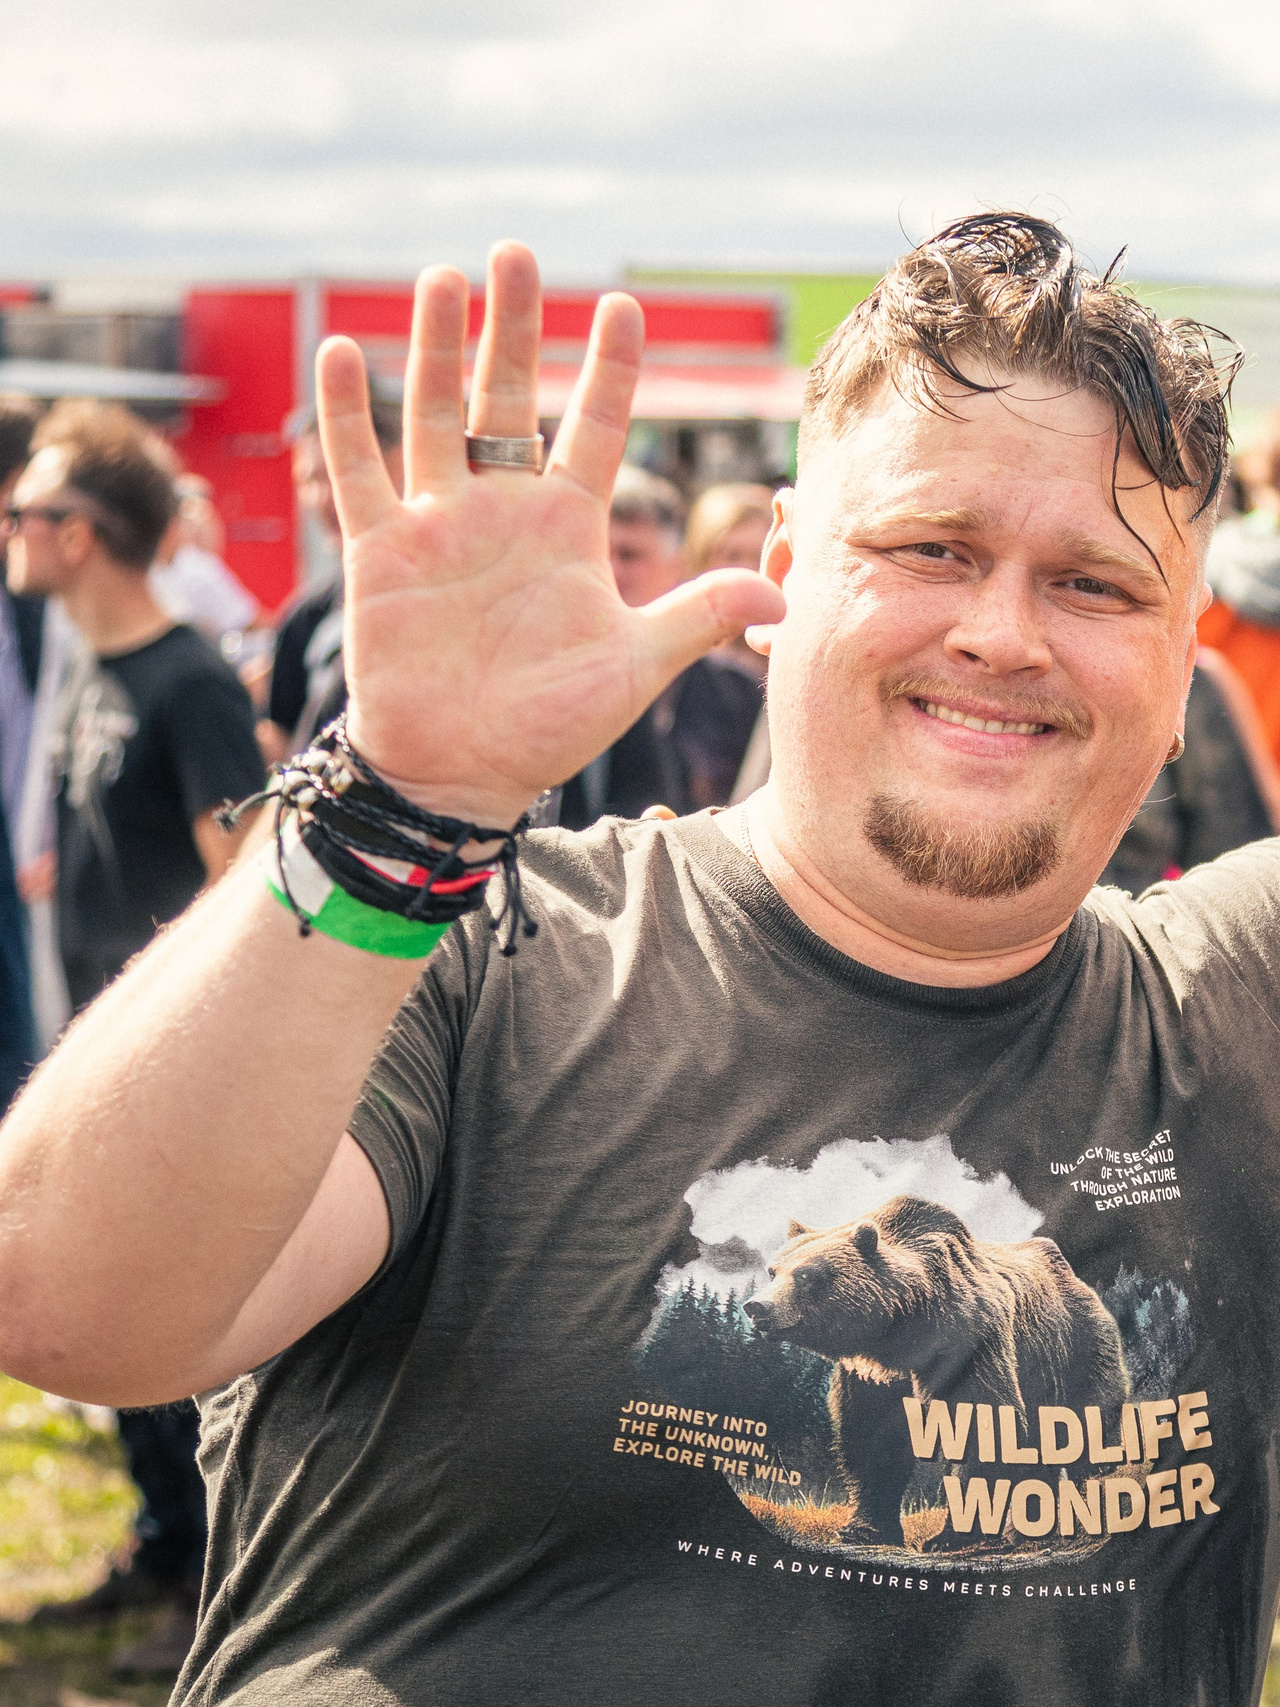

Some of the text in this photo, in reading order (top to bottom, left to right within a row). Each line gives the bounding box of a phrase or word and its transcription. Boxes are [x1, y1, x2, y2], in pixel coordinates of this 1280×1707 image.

[1050, 1129, 1171, 1175] UNLOCK THE SECRET
[1101, 1148, 1174, 1179] OF THE WILD
[1070, 1167, 1177, 1196] THROUGH NATURE
[1095, 1185, 1181, 1211] EXPLORATION
[618, 1418, 770, 1461] THE UNKNOWN,
[621, 1400, 768, 1437] JOURNEY INTO
[902, 1391, 1213, 1465] WILDLIFE
[613, 1437, 802, 1486] EXPLORE THE WILD
[943, 1462, 1221, 1537] WONDER
[677, 1540, 1137, 1597] WHERE ADVENTURES MEETS CHALLENGE
